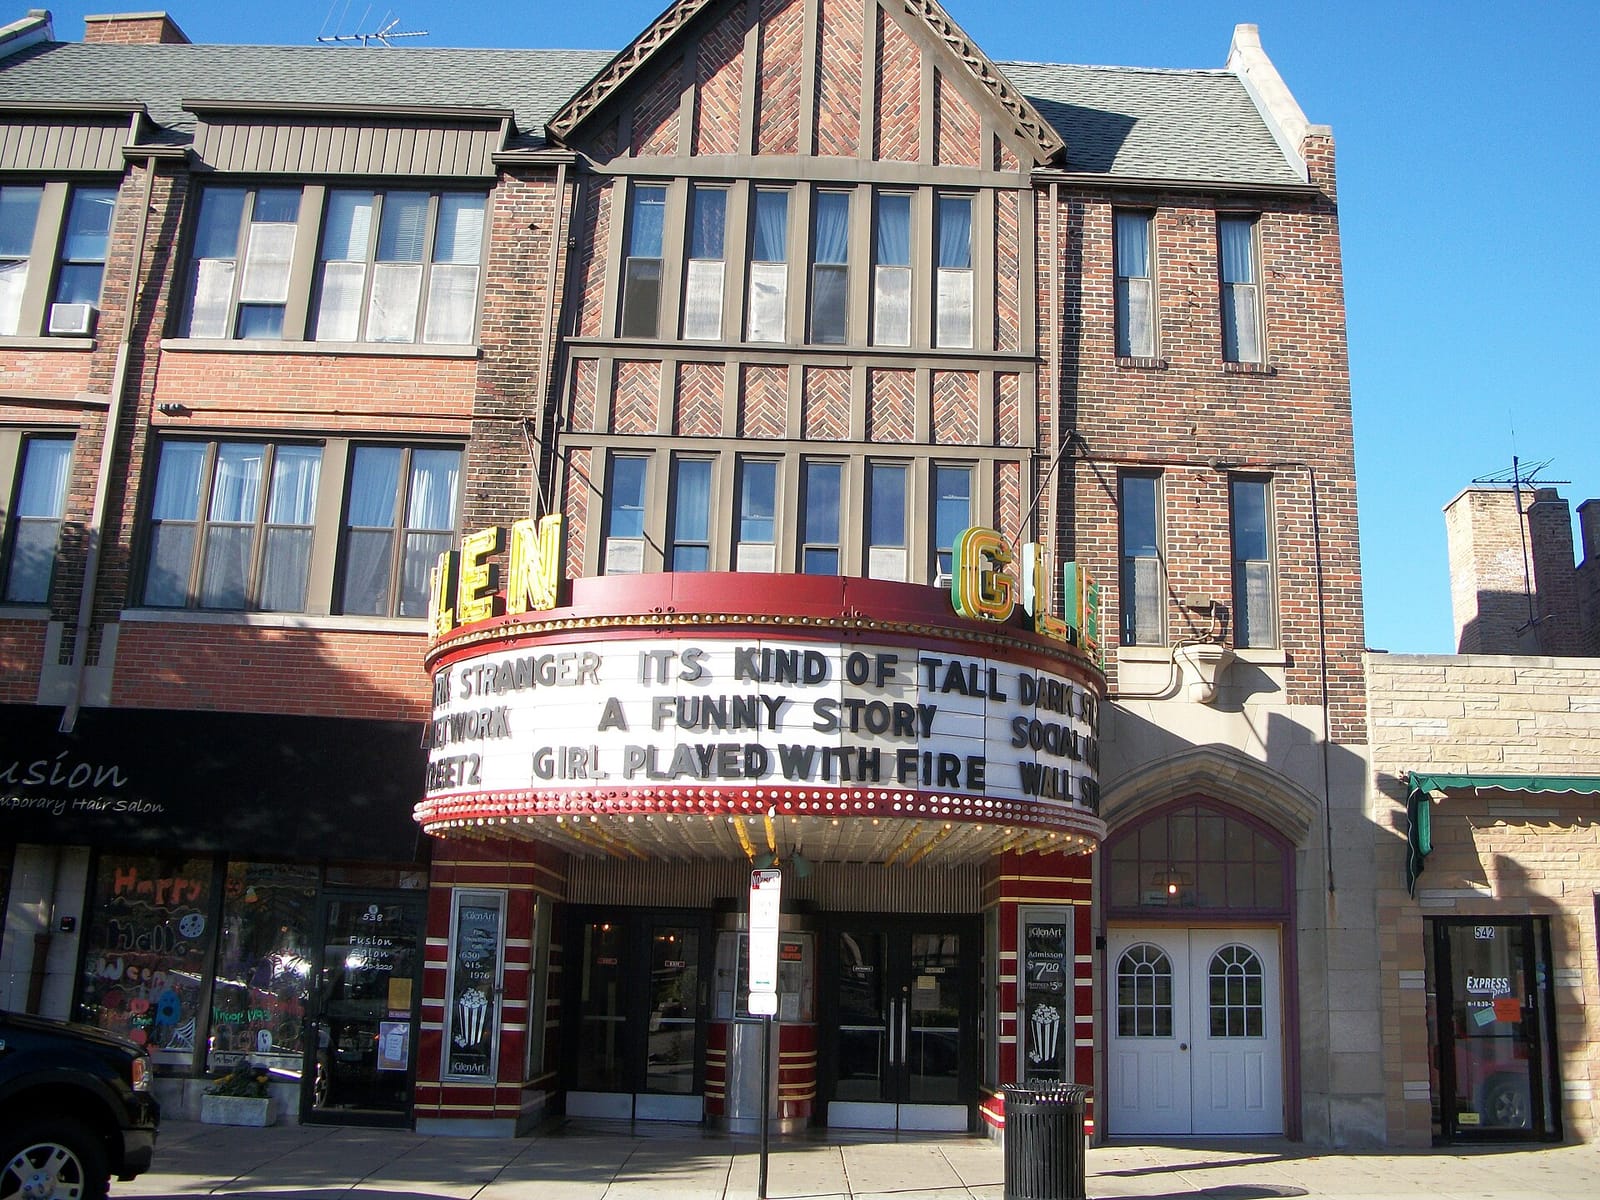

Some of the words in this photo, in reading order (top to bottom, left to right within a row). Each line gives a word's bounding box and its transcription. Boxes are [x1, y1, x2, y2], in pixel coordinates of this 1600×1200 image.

[460, 651, 602, 700] STRANGER
[638, 647, 705, 685] ITS
[734, 647, 827, 684] KIND
[845, 651, 899, 688] OF
[920, 657, 1007, 703] TALL
[1019, 672, 1075, 718] DARK
[597, 696, 629, 732] A
[651, 695, 787, 732] FUNNY
[812, 697, 938, 739] STORY
[1011, 715, 1082, 762] SOCIAL
[532, 744, 607, 780] GIRL
[623, 743, 768, 780] PLAYED
[777, 743, 881, 783] WITH
[896, 748, 986, 790] FIRE
[1018, 761, 1073, 802] WALL
[72, 797, 111, 811] Hair
[112, 800, 165, 813] Salon
[362, 913, 384, 922] 538
[1475, 926, 1495, 938] 542
[349, 935, 393, 946] Fusion
[454, 1062, 486, 1073] GlenArt
